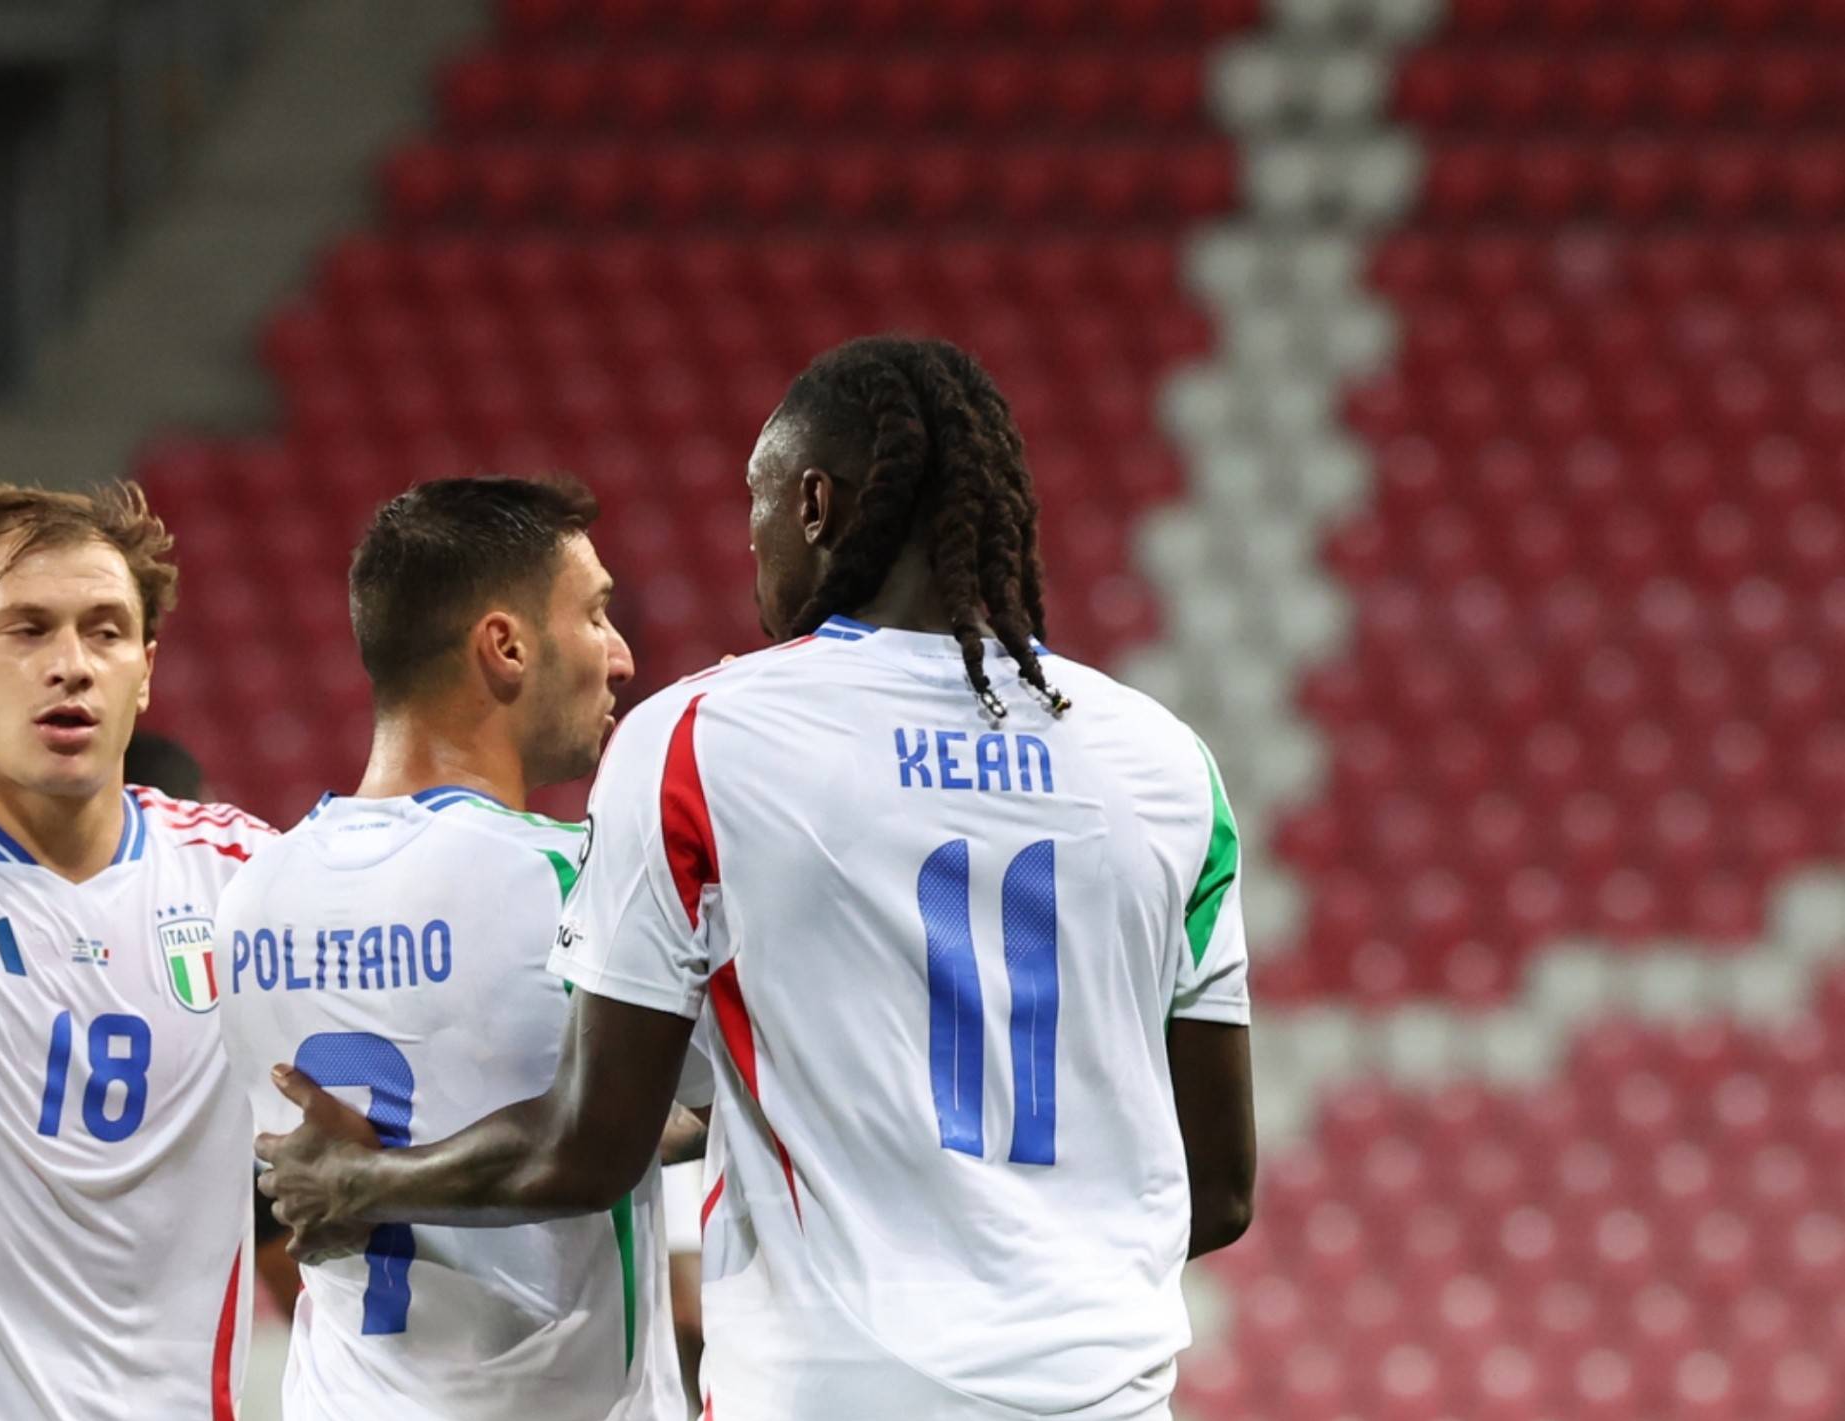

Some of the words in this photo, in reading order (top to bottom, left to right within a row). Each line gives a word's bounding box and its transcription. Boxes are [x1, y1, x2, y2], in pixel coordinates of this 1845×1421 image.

[894, 728, 1054, 794] KEAN
[162, 925, 213, 947] ITALIA
[233, 919, 453, 992] POLITANO
[917, 838, 1061, 1167] 11
[38, 1011, 152, 1143] 18
